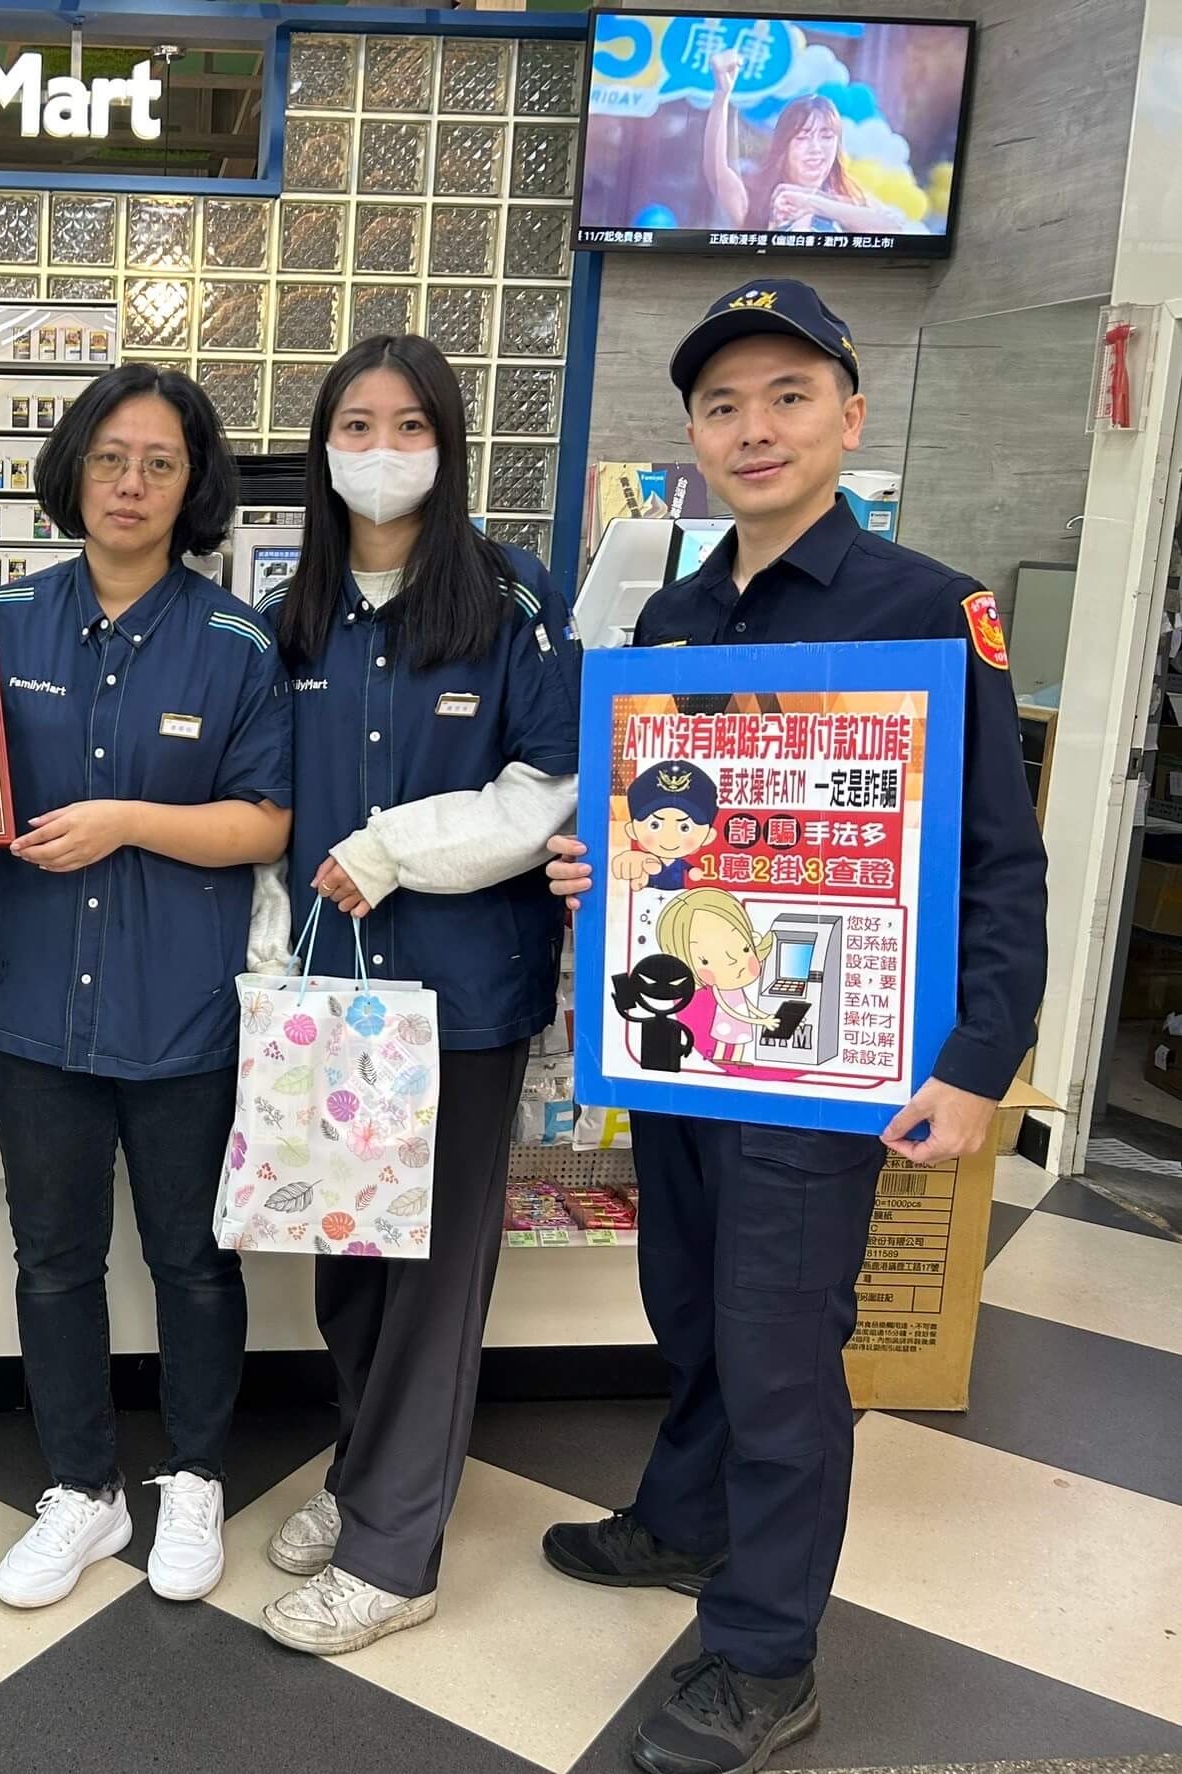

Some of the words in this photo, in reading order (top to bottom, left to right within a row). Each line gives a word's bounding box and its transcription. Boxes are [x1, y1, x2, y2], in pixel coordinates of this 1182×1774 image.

[9, 676, 67, 696] FamilyMart
[293, 679, 328, 691] ilyMart
[623, 714, 912, 761] ATM沒有解除分期付款功能
[719, 767, 806, 806] 要求操作ATM
[814, 768, 898, 809] 一定是詐騙
[728, 817, 887, 849] 詐騙手法多
[700, 854, 895, 889] 1聽2掛3查證
[846, 935, 898, 952] 因系統
[846, 953, 898, 971] 設定錯
[845, 972, 897, 990] 誤，要
[844, 991, 889, 1009] 至ATM
[843, 1010, 897, 1029] 操作才
[843, 1029, 895, 1048] 可以解
[842, 1048, 894, 1067] 除設定
[870, 1223, 878, 1232] C
